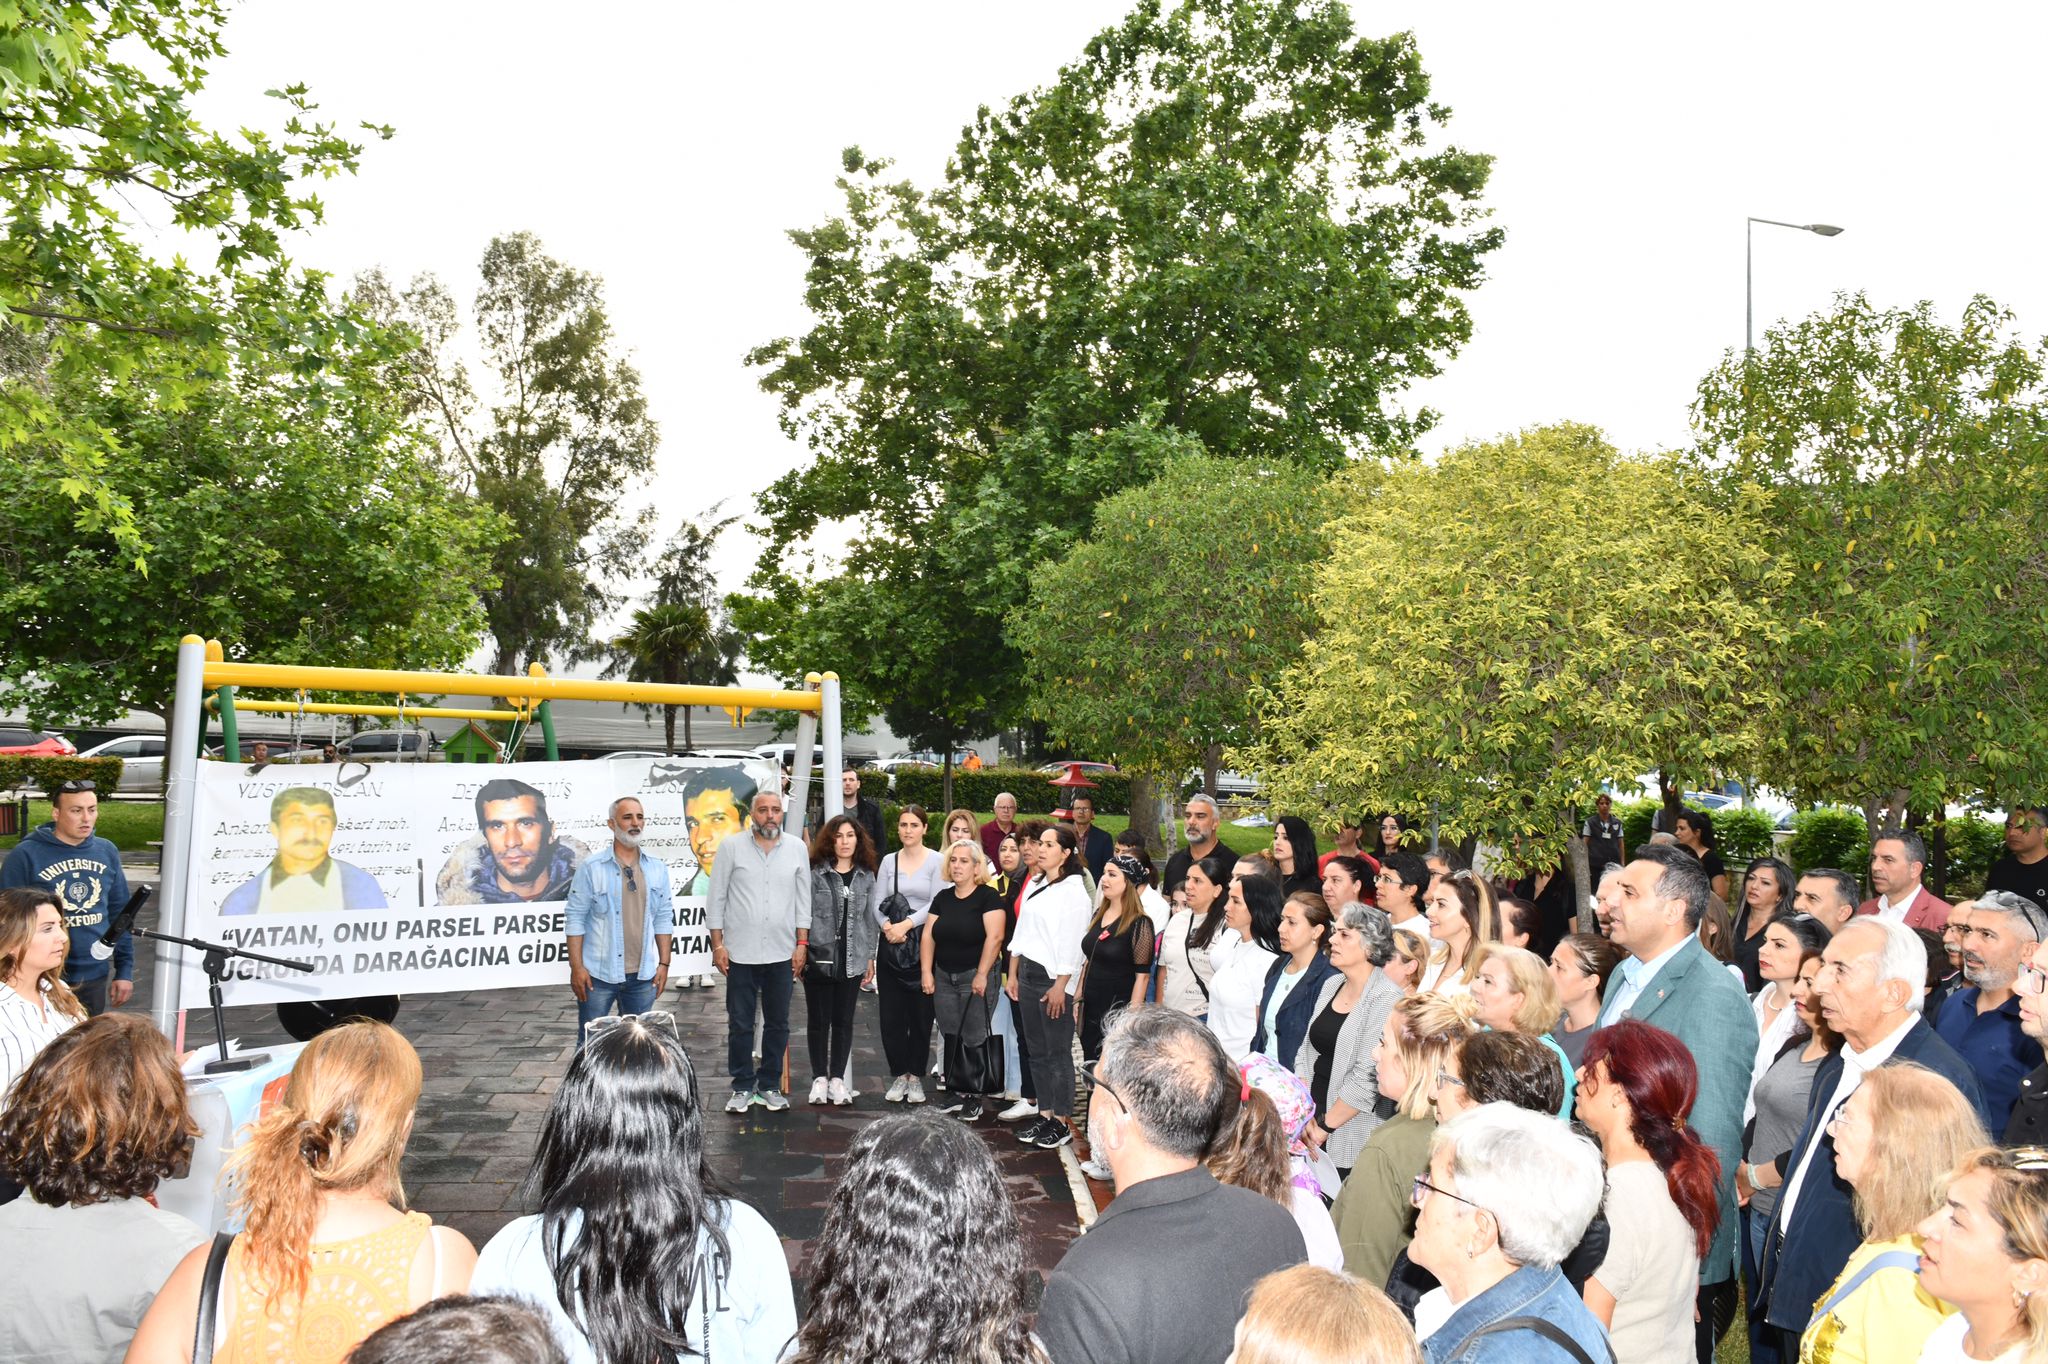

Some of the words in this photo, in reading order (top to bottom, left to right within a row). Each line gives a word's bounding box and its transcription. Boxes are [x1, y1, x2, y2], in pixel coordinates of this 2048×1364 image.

[38, 858, 107, 882] UNIVERSITY
[63, 912, 103, 928] XFORD
[333, 920, 388, 944] ONU
[395, 917, 485, 940] PARSEL
[493, 913, 565, 935] PARSE
[353, 943, 510, 974] DARAĞACINA
[518, 939, 569, 964] GİDE
[670, 934, 713, 955] ATAN
